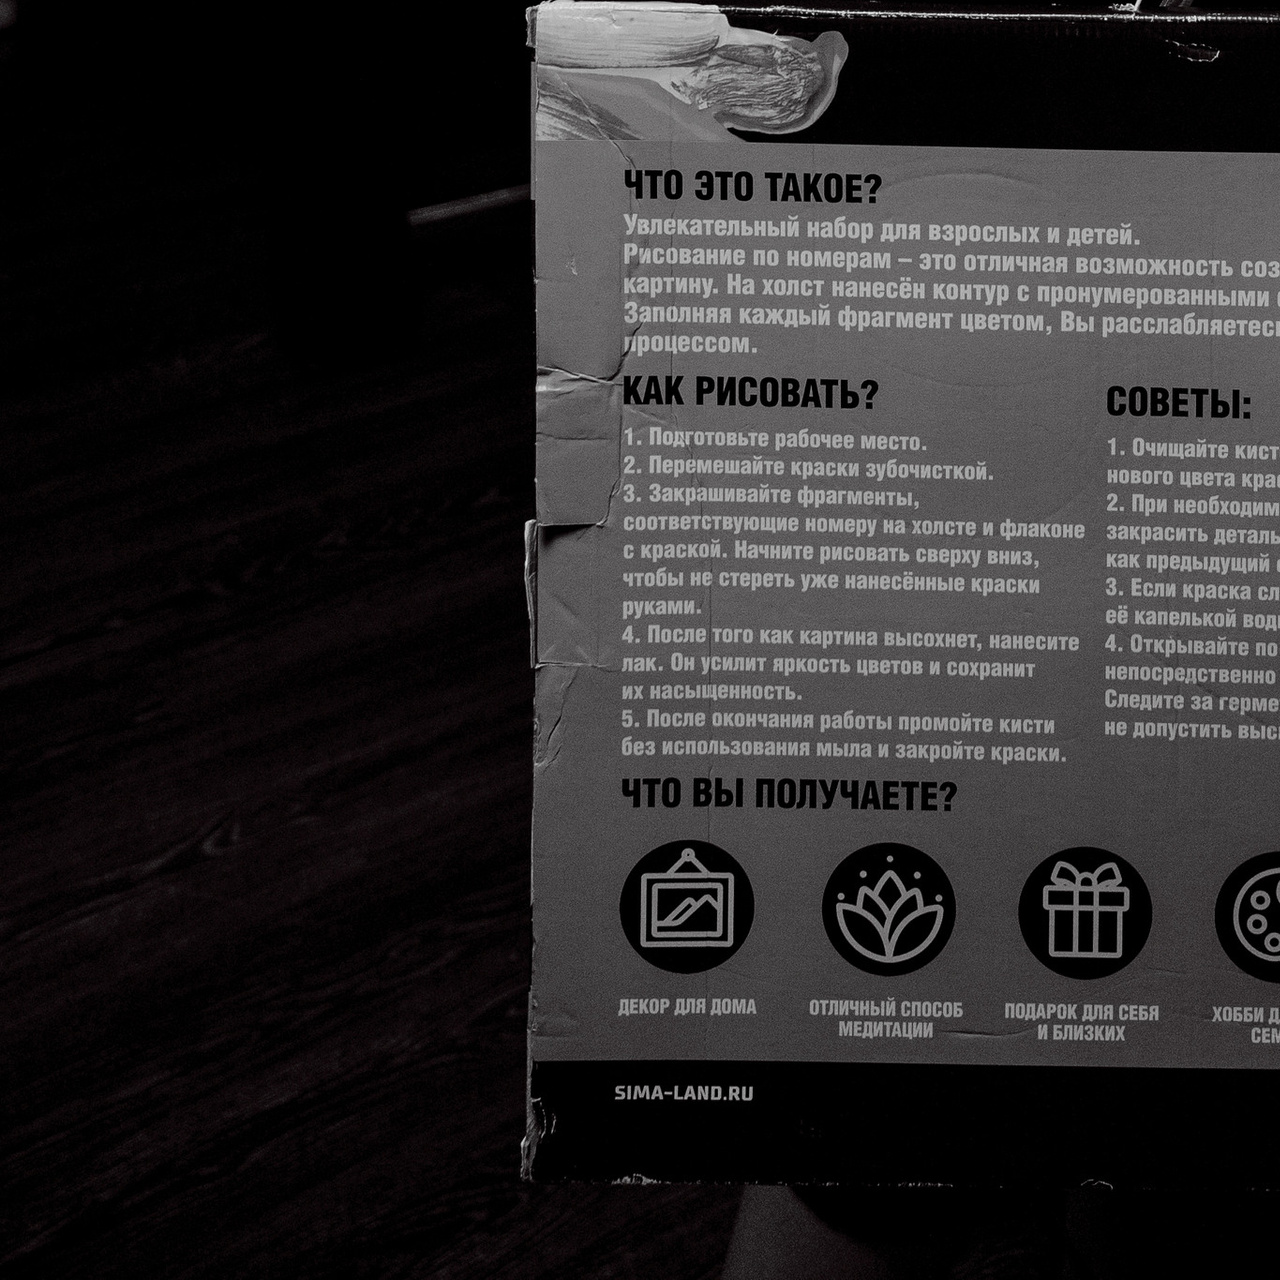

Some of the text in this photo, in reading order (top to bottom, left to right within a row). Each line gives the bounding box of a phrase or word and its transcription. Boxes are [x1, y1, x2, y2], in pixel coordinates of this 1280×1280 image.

[625, 169, 881, 204] ЧТО ЭТО ТАКОЕ?
[624, 214, 1139, 247] Увлекательный набор для взрослых и детей.
[624, 242, 745, 265] Рисование
[754, 250, 779, 266] по
[787, 250, 890, 272] номерам
[920, 253, 956, 271] это
[964, 254, 1067, 273] отличная
[1076, 256, 1233, 277] возможность
[624, 276, 718, 298] картину.
[728, 274, 754, 295] На
[763, 278, 824, 296] холст
[832, 277, 925, 299] нанесён
[934, 283, 1009, 306] контур
[1018, 285, 1029, 302] с
[1038, 285, 1269, 309] пронумерованными
[624, 301, 731, 324] Заполняя
[740, 303, 830, 328] каждый
[838, 305, 953, 331] фрагмент
[961, 313, 1051, 335] цветом,
[1061, 310, 1094, 333] Вы
[625, 334, 757, 357] процессом.
[624, 375, 878, 409] КАК РИСОВАТЬ?
[1107, 386, 1250, 419] СОВЕТЫ:
[625, 427, 926, 451] 1. Подготовьте рабочее место.
[1108, 438, 1124, 456] 1.
[1133, 437, 1228, 459] Очищайте
[624, 455, 993, 482] 2. Перемешайте краски зубочисткой.
[1108, 469, 1173, 485] нового
[1180, 471, 1235, 488] цвета
[624, 483, 919, 509] 3. Закрашивайте фрагменты,
[1107, 492, 1124, 512] 2.
[1132, 493, 1167, 516] При
[624, 514, 1085, 541] соответствующие номеру на холсте и флаконе
[1107, 524, 1208, 544] закрасить
[1214, 528, 1280, 545] деталь
[624, 539, 1039, 568] с краской. Начните рисовать сверху вниз,
[1107, 553, 1139, 569] как
[1147, 553, 1269, 575] предыдущий
[623, 566, 1039, 597] чтобы не стереть уже нанесённые краски
[623, 600, 701, 620] руками.
[622, 624, 1079, 651] 4. После того как картина высохнет, нанесите
[622, 652, 1035, 681] лак. Он усилит яркость цветов и сохранит
[1105, 688, 1184, 710] Следите
[1191, 695, 1212, 711] за
[1105, 721, 1127, 736] не
[1133, 721, 1232, 741] допустить
[622, 777, 957, 812] ЧТО ВЫ ПОЛУЧАЕТЕ?
[618, 998, 756, 1017] ДЕКОР ДЛЯ ДОМА
[810, 997, 963, 1018] ОТЛИЧНЫЙ СПОСОБ
[1005, 1003, 1159, 1022] ПОДАРОК ДЛЯ СЕБЯ
[1213, 1006, 1263, 1023] ХОББИ
[839, 1020, 933, 1040] МЕДИТАЦИИ
[1038, 1023, 1125, 1041] И БЛИЗКИХ
[615, 1085, 753, 1101] SIMA-LAND.RU
